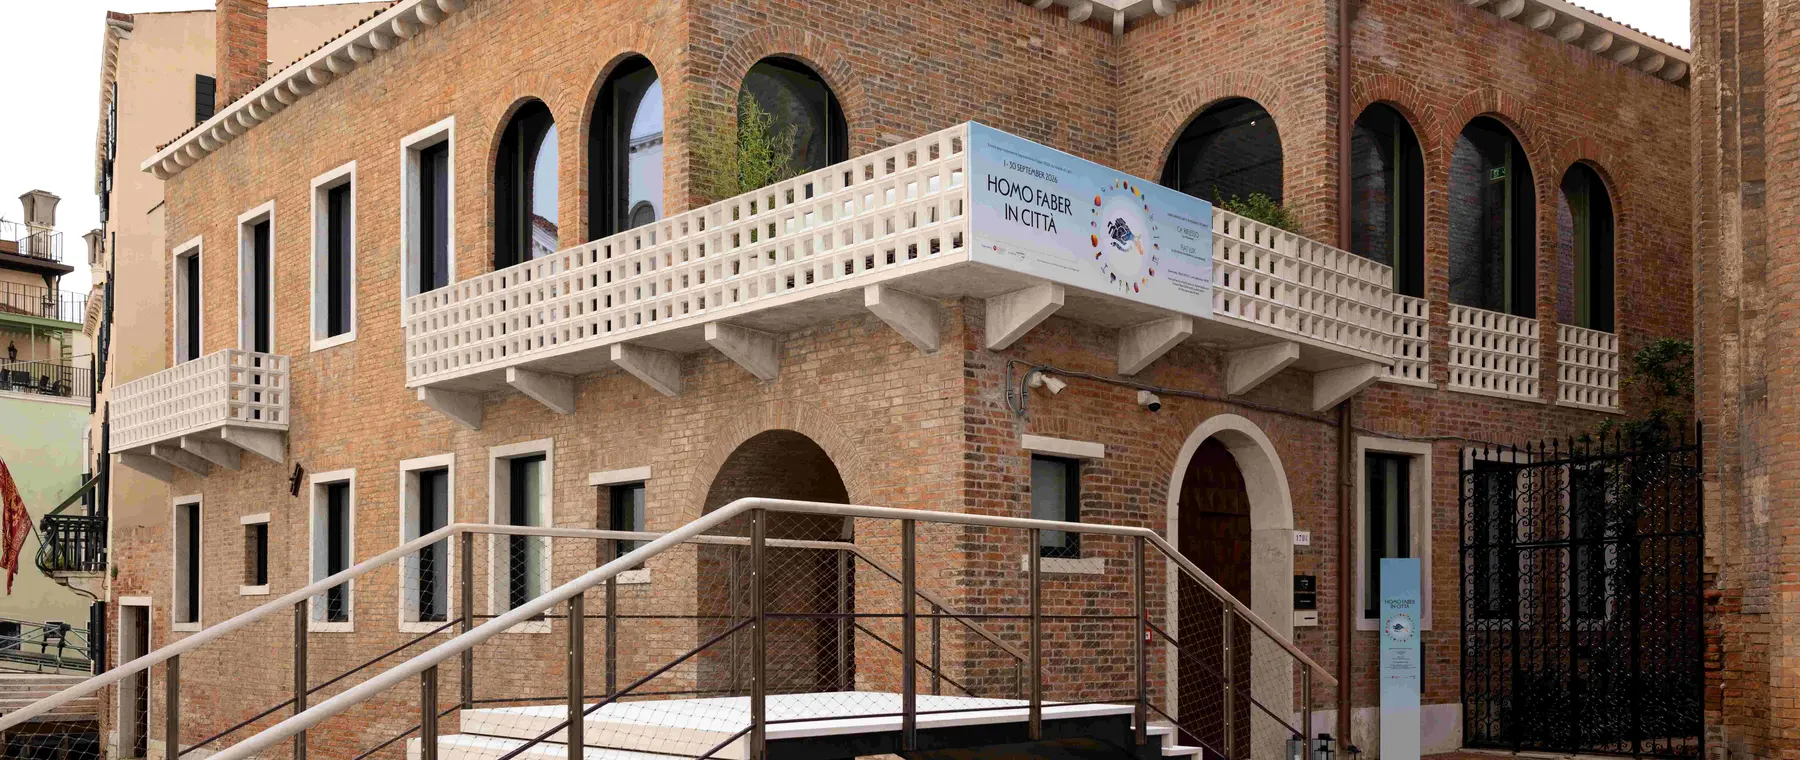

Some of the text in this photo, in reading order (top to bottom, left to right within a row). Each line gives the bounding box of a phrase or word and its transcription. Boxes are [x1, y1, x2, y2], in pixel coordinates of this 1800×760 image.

[1017, 163, 1045, 180] SEPTEMBER
[1045, 172, 1059, 184] 2026
[987, 173, 1073, 216] HOMO FABER
[1005, 203, 1058, 235] IN CITTÀ
